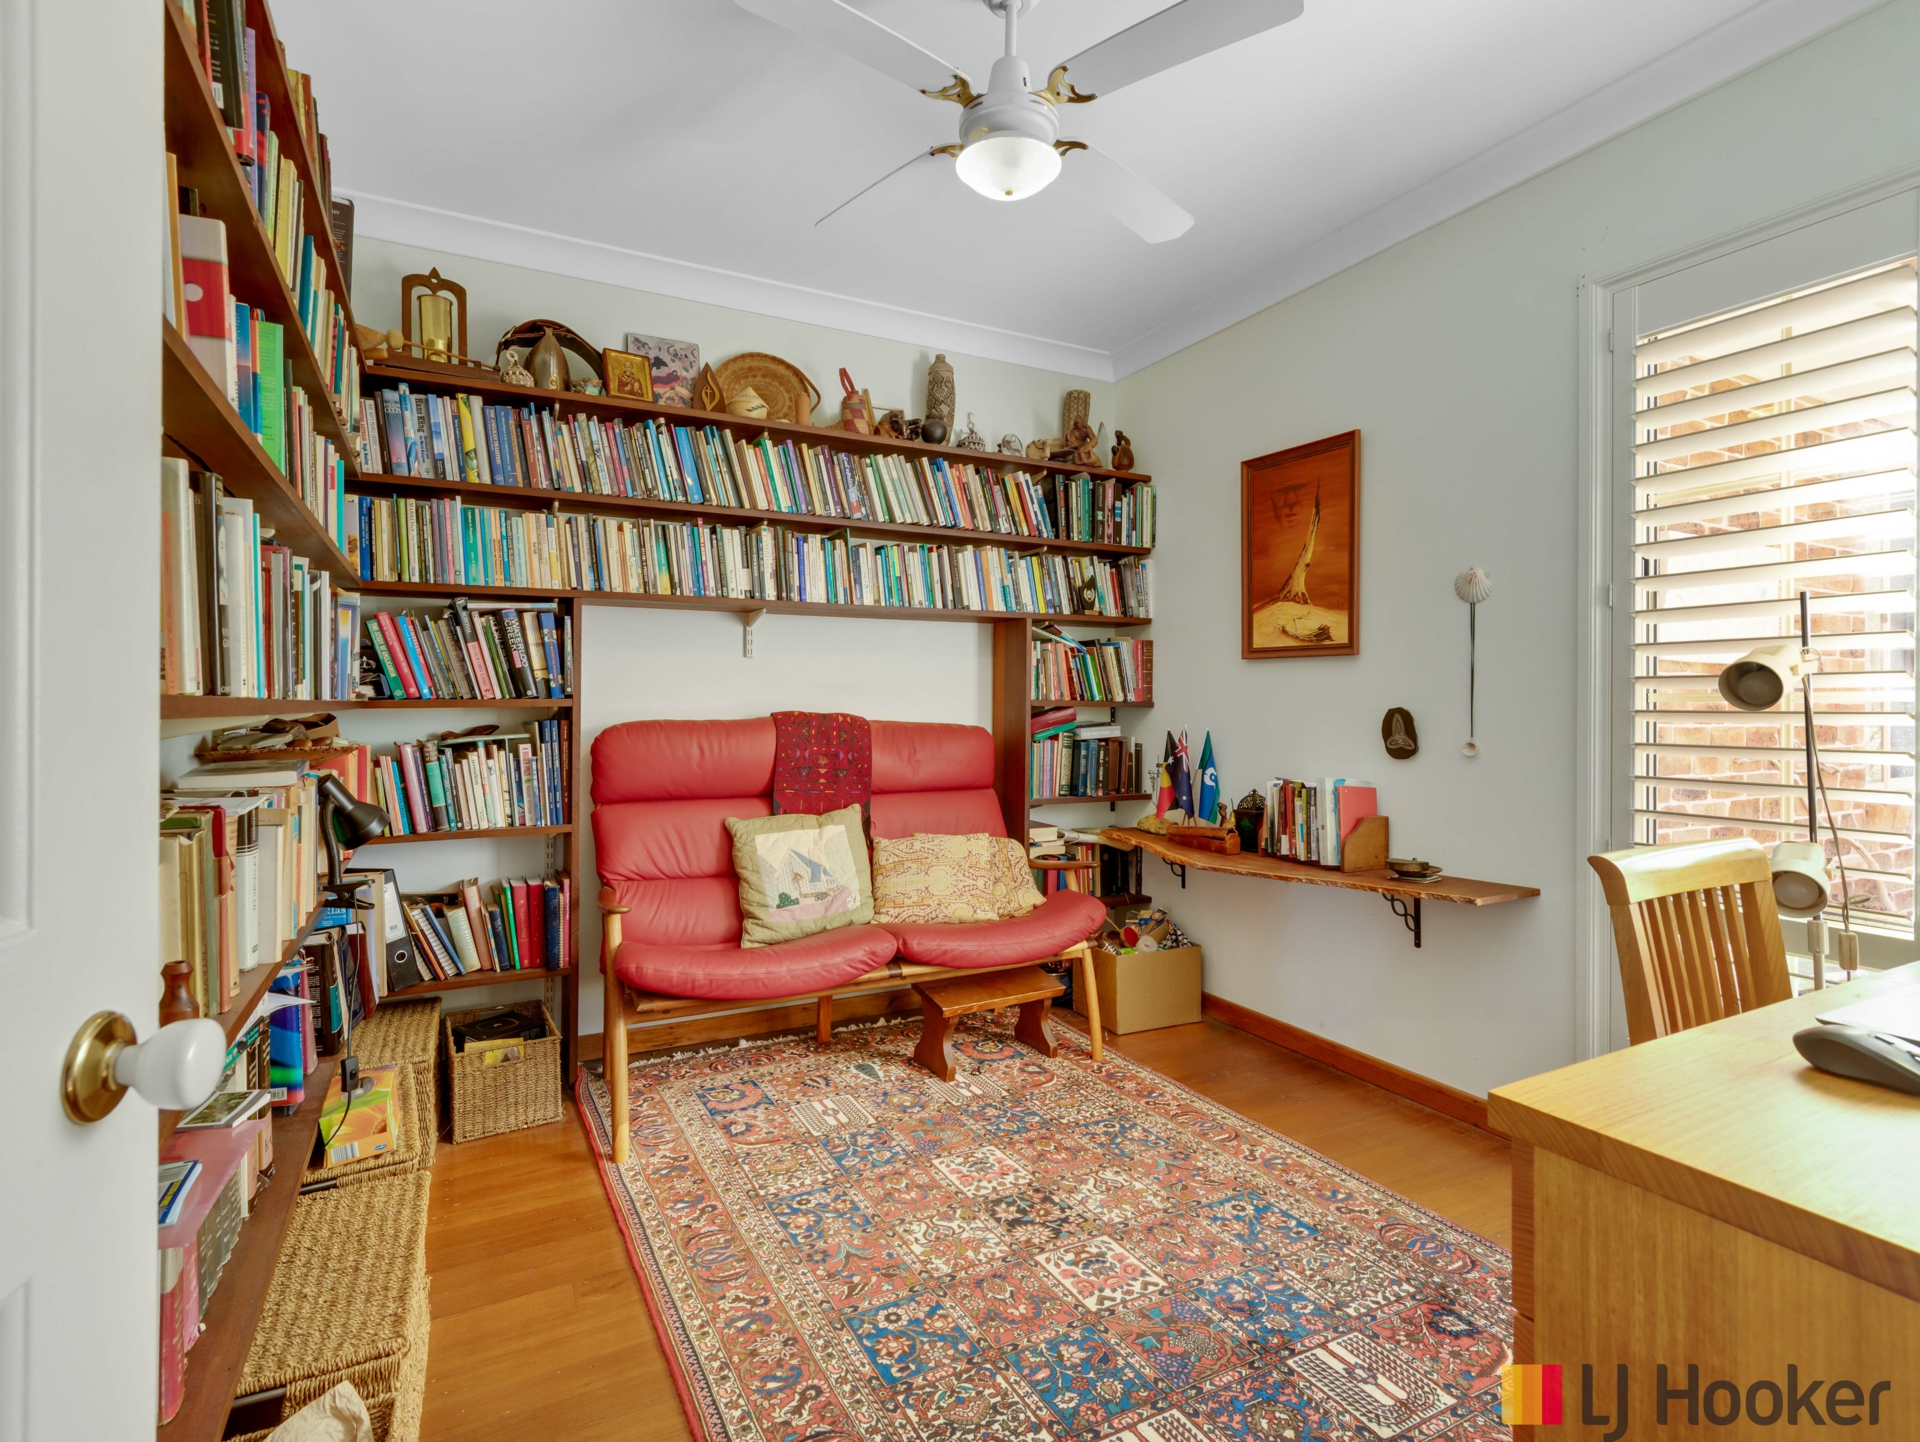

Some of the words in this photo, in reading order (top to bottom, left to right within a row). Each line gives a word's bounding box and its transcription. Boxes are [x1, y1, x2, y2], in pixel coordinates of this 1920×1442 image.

[415, 398, 423, 415] Hans
[416, 416, 425, 433] Küng
[490, 419, 498, 440] ANGLICAN
[493, 441, 501, 465] TRADITION
[371, 622, 380, 631] THE
[462, 611, 472, 634] SURVIVAL
[373, 631, 384, 645] STUDY
[504, 619, 518, 652] CREEK
[511, 618, 529, 668] WATERLOO
[381, 651, 396, 678] ANGLICANISM
[480, 673, 488, 687] LAND
